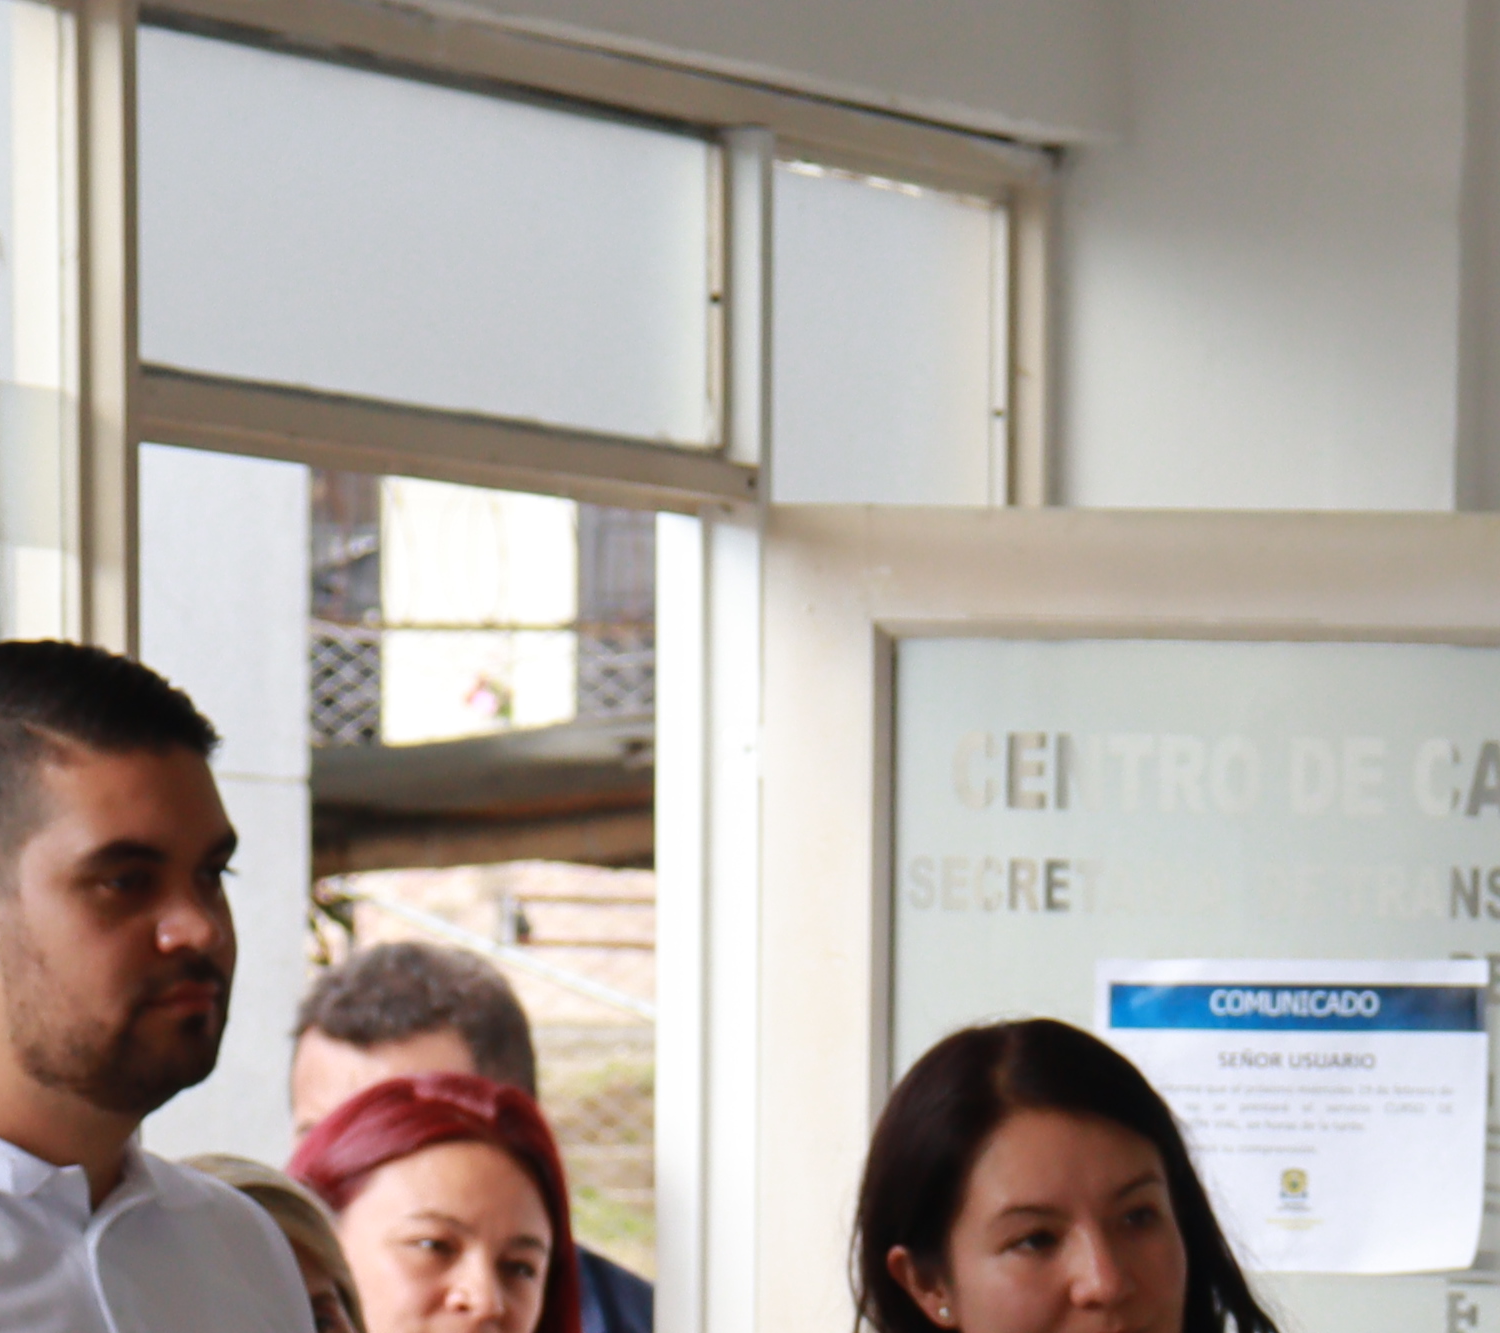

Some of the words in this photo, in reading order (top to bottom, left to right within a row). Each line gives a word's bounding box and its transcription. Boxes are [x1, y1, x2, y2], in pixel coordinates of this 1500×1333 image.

[953, 729, 1257, 814] CENTRO
[1290, 732, 1390, 814] DE
[1209, 988, 1381, 1018] COMUNICADO
[1218, 1048, 1282, 1070] SEÑOR
[1288, 1053, 1376, 1070] USUARIO
